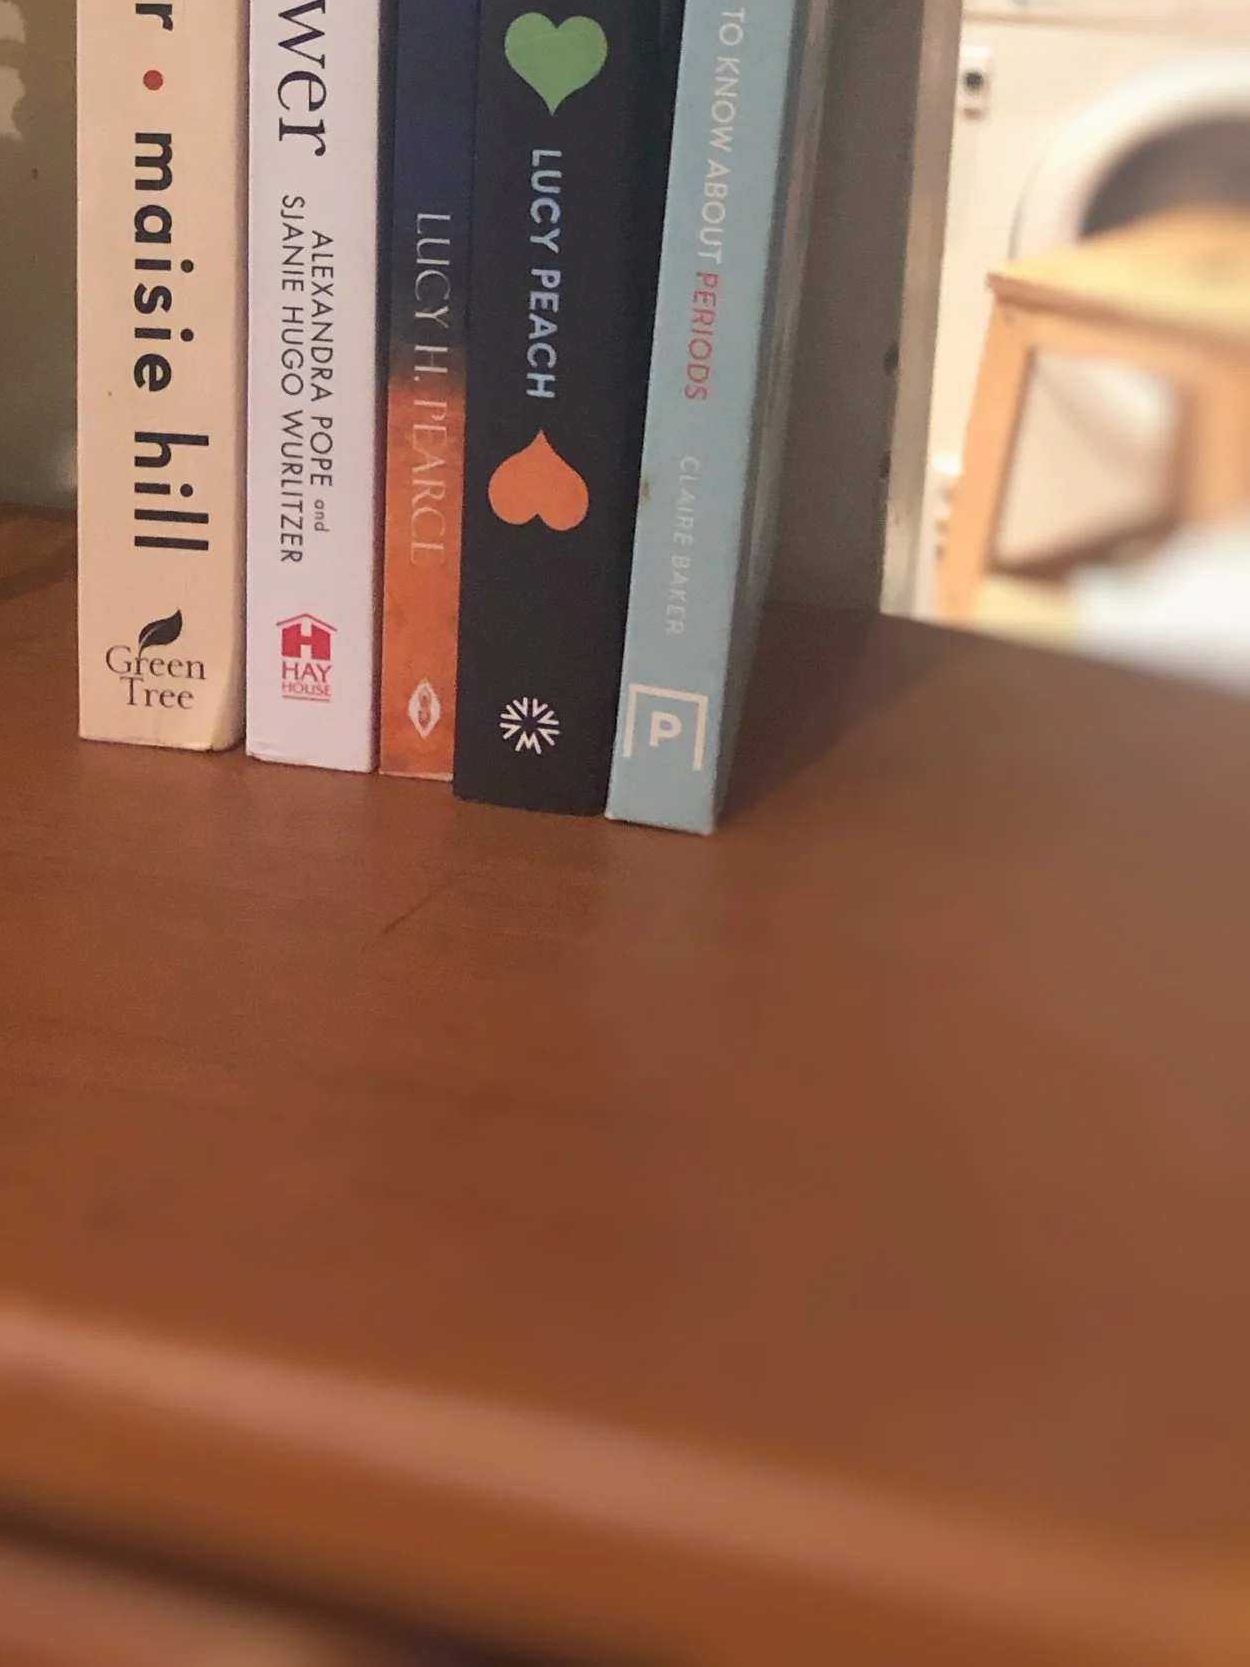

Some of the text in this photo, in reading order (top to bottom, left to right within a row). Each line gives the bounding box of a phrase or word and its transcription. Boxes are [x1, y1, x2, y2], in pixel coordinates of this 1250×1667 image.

[718, 8, 746, 50] TO
[704, 55, 741, 153] KNOW
[134, 133, 194, 393] maisie
[696, 159, 728, 264] ABOUT
[525, 150, 562, 399] LUCY PEACH
[279, 196, 305, 564] SJANIE HUGO WURLITZER
[309, 231, 334, 533] ALEXANDRA POPE and
[409, 212, 451, 564] LUCY H. PEARCE
[684, 271, 718, 401] PERIODS
[134, 432, 209, 551] hill
[664, 456, 698, 635] CLAIRE BAKER
[106, 645, 206, 681] Green
[120, 676, 194, 710] Tree
[282, 661, 332, 683] HAY
[282, 681, 331, 697] HOUSE
[649, 711, 681, 747] P
